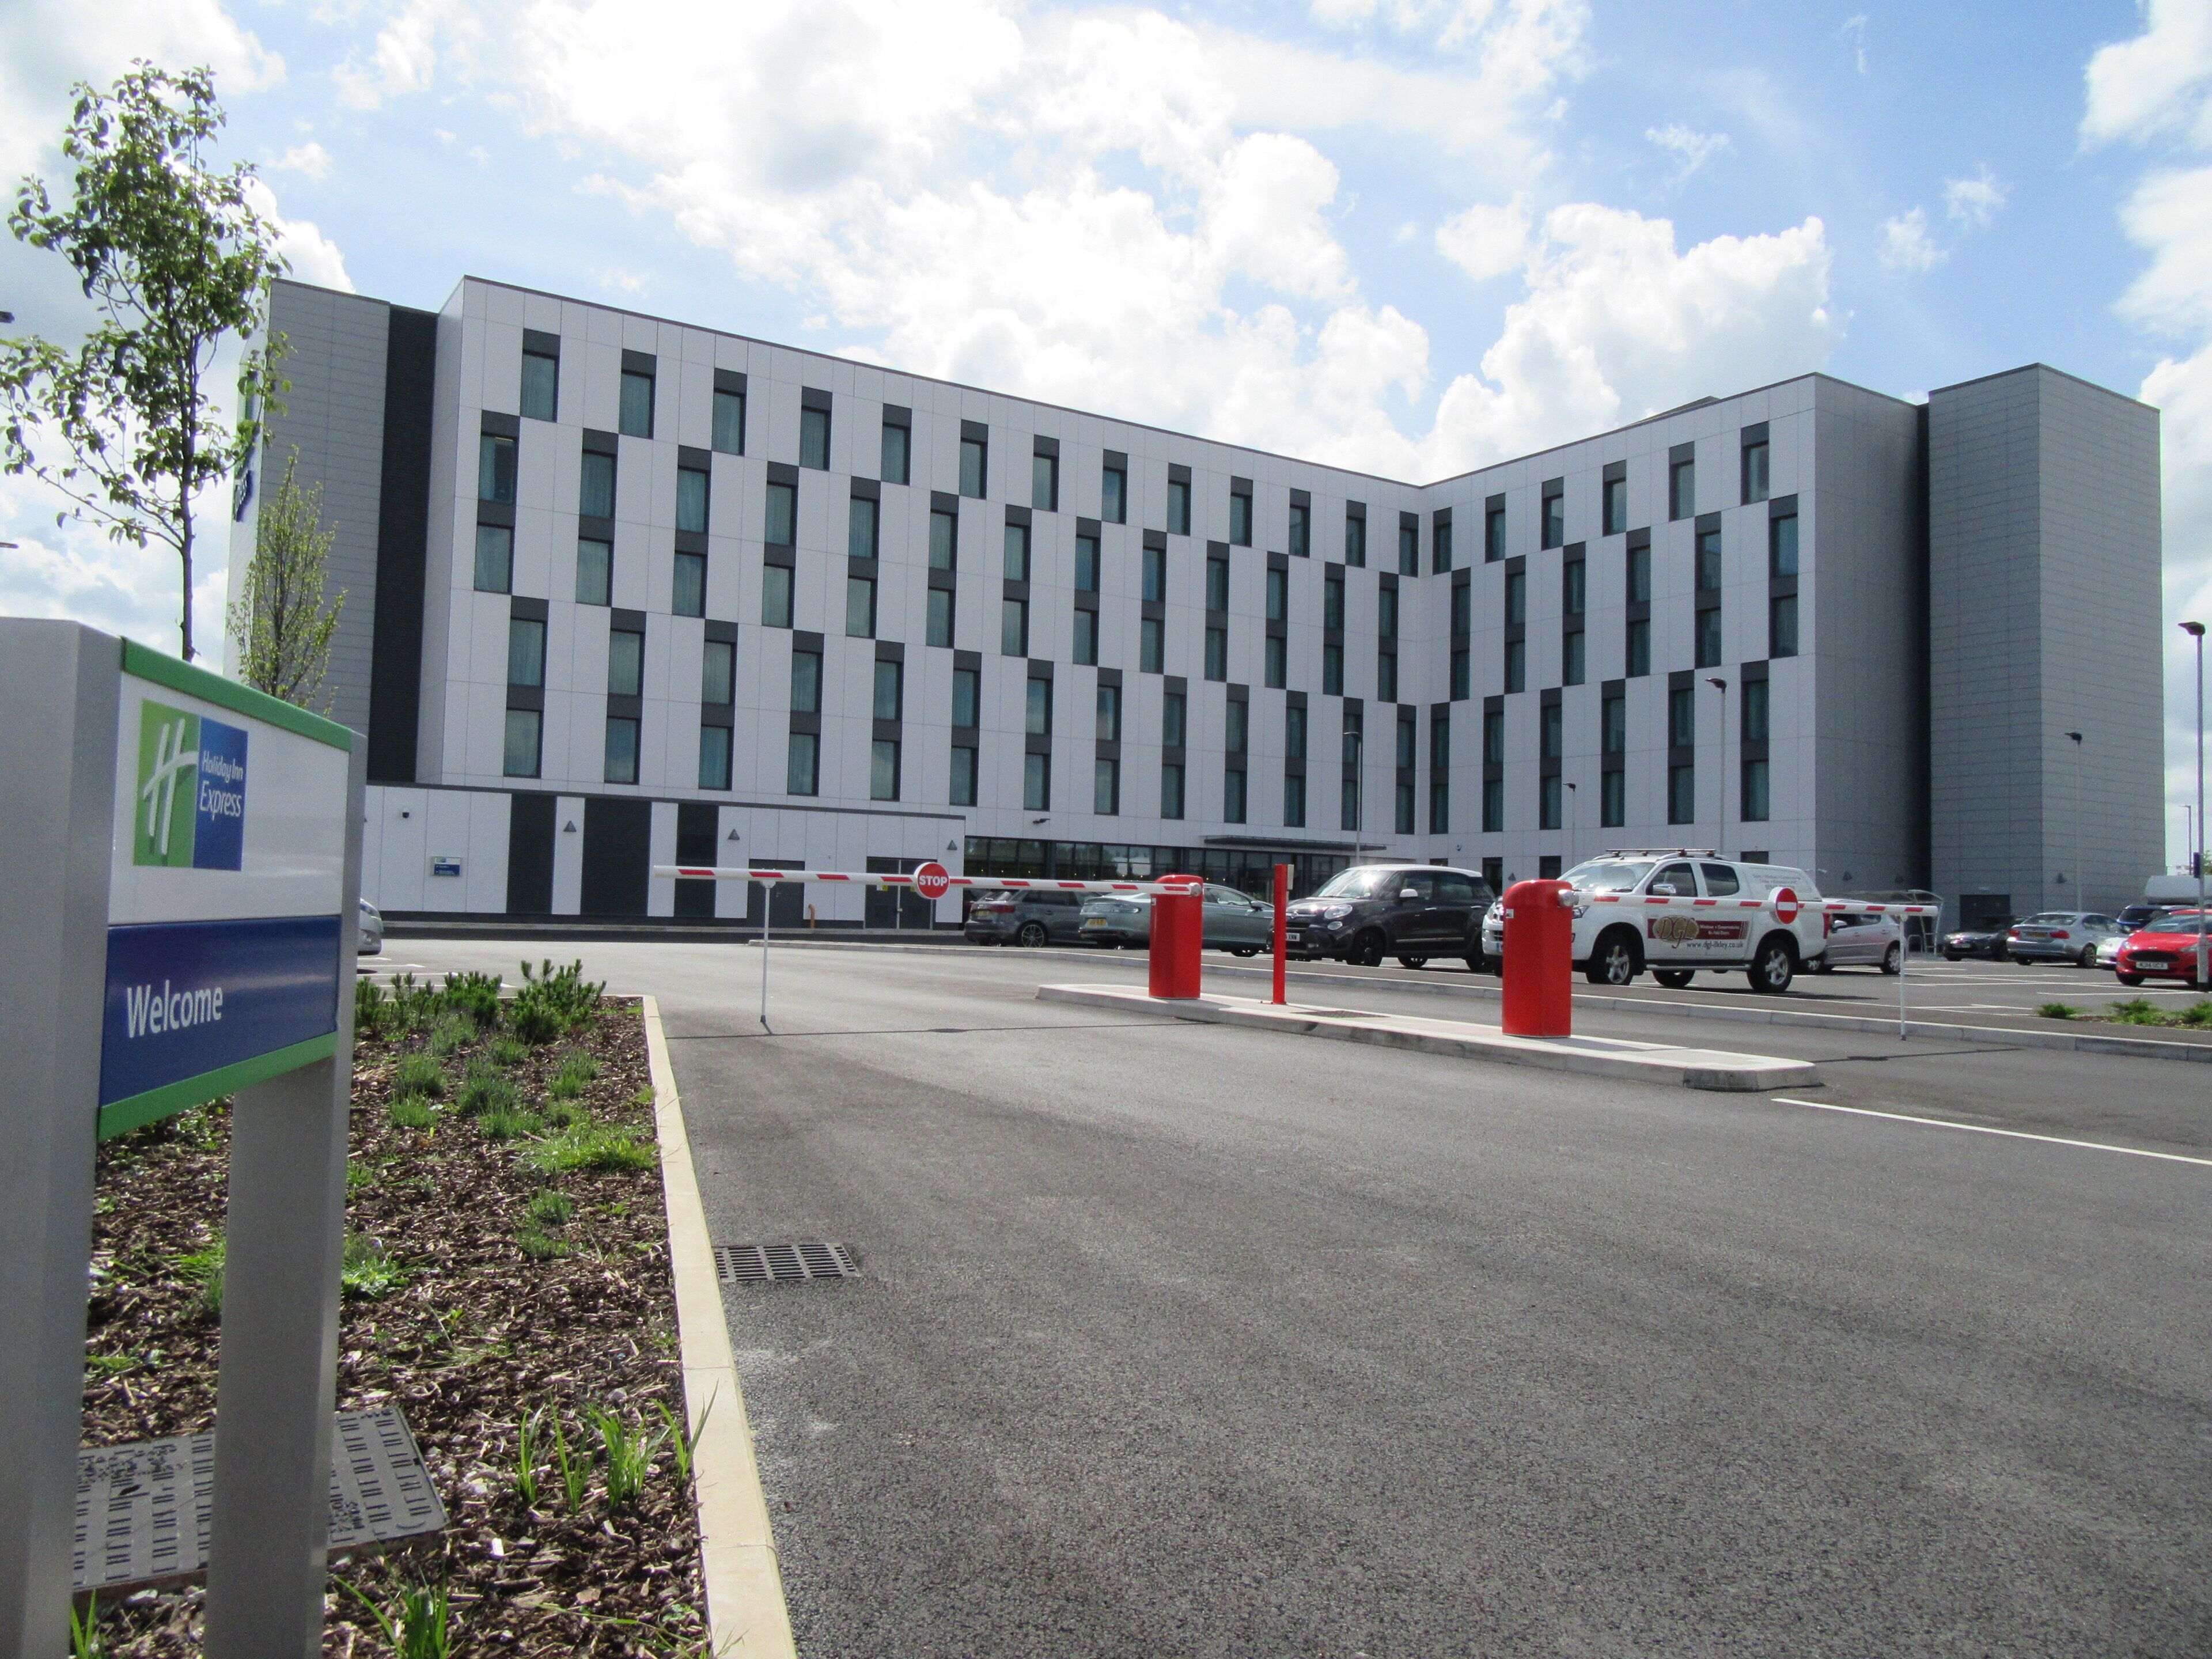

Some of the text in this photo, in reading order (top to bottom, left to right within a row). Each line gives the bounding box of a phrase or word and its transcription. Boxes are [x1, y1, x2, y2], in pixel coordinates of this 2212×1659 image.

[202, 750, 243, 783] Holiday Inn
[199, 780, 242, 821] Express
[919, 875, 948, 886] STOP
[1687, 941, 1743, 949] www.dgl-ilkley.co.uk
[127, 979, 224, 1037] Welcome
